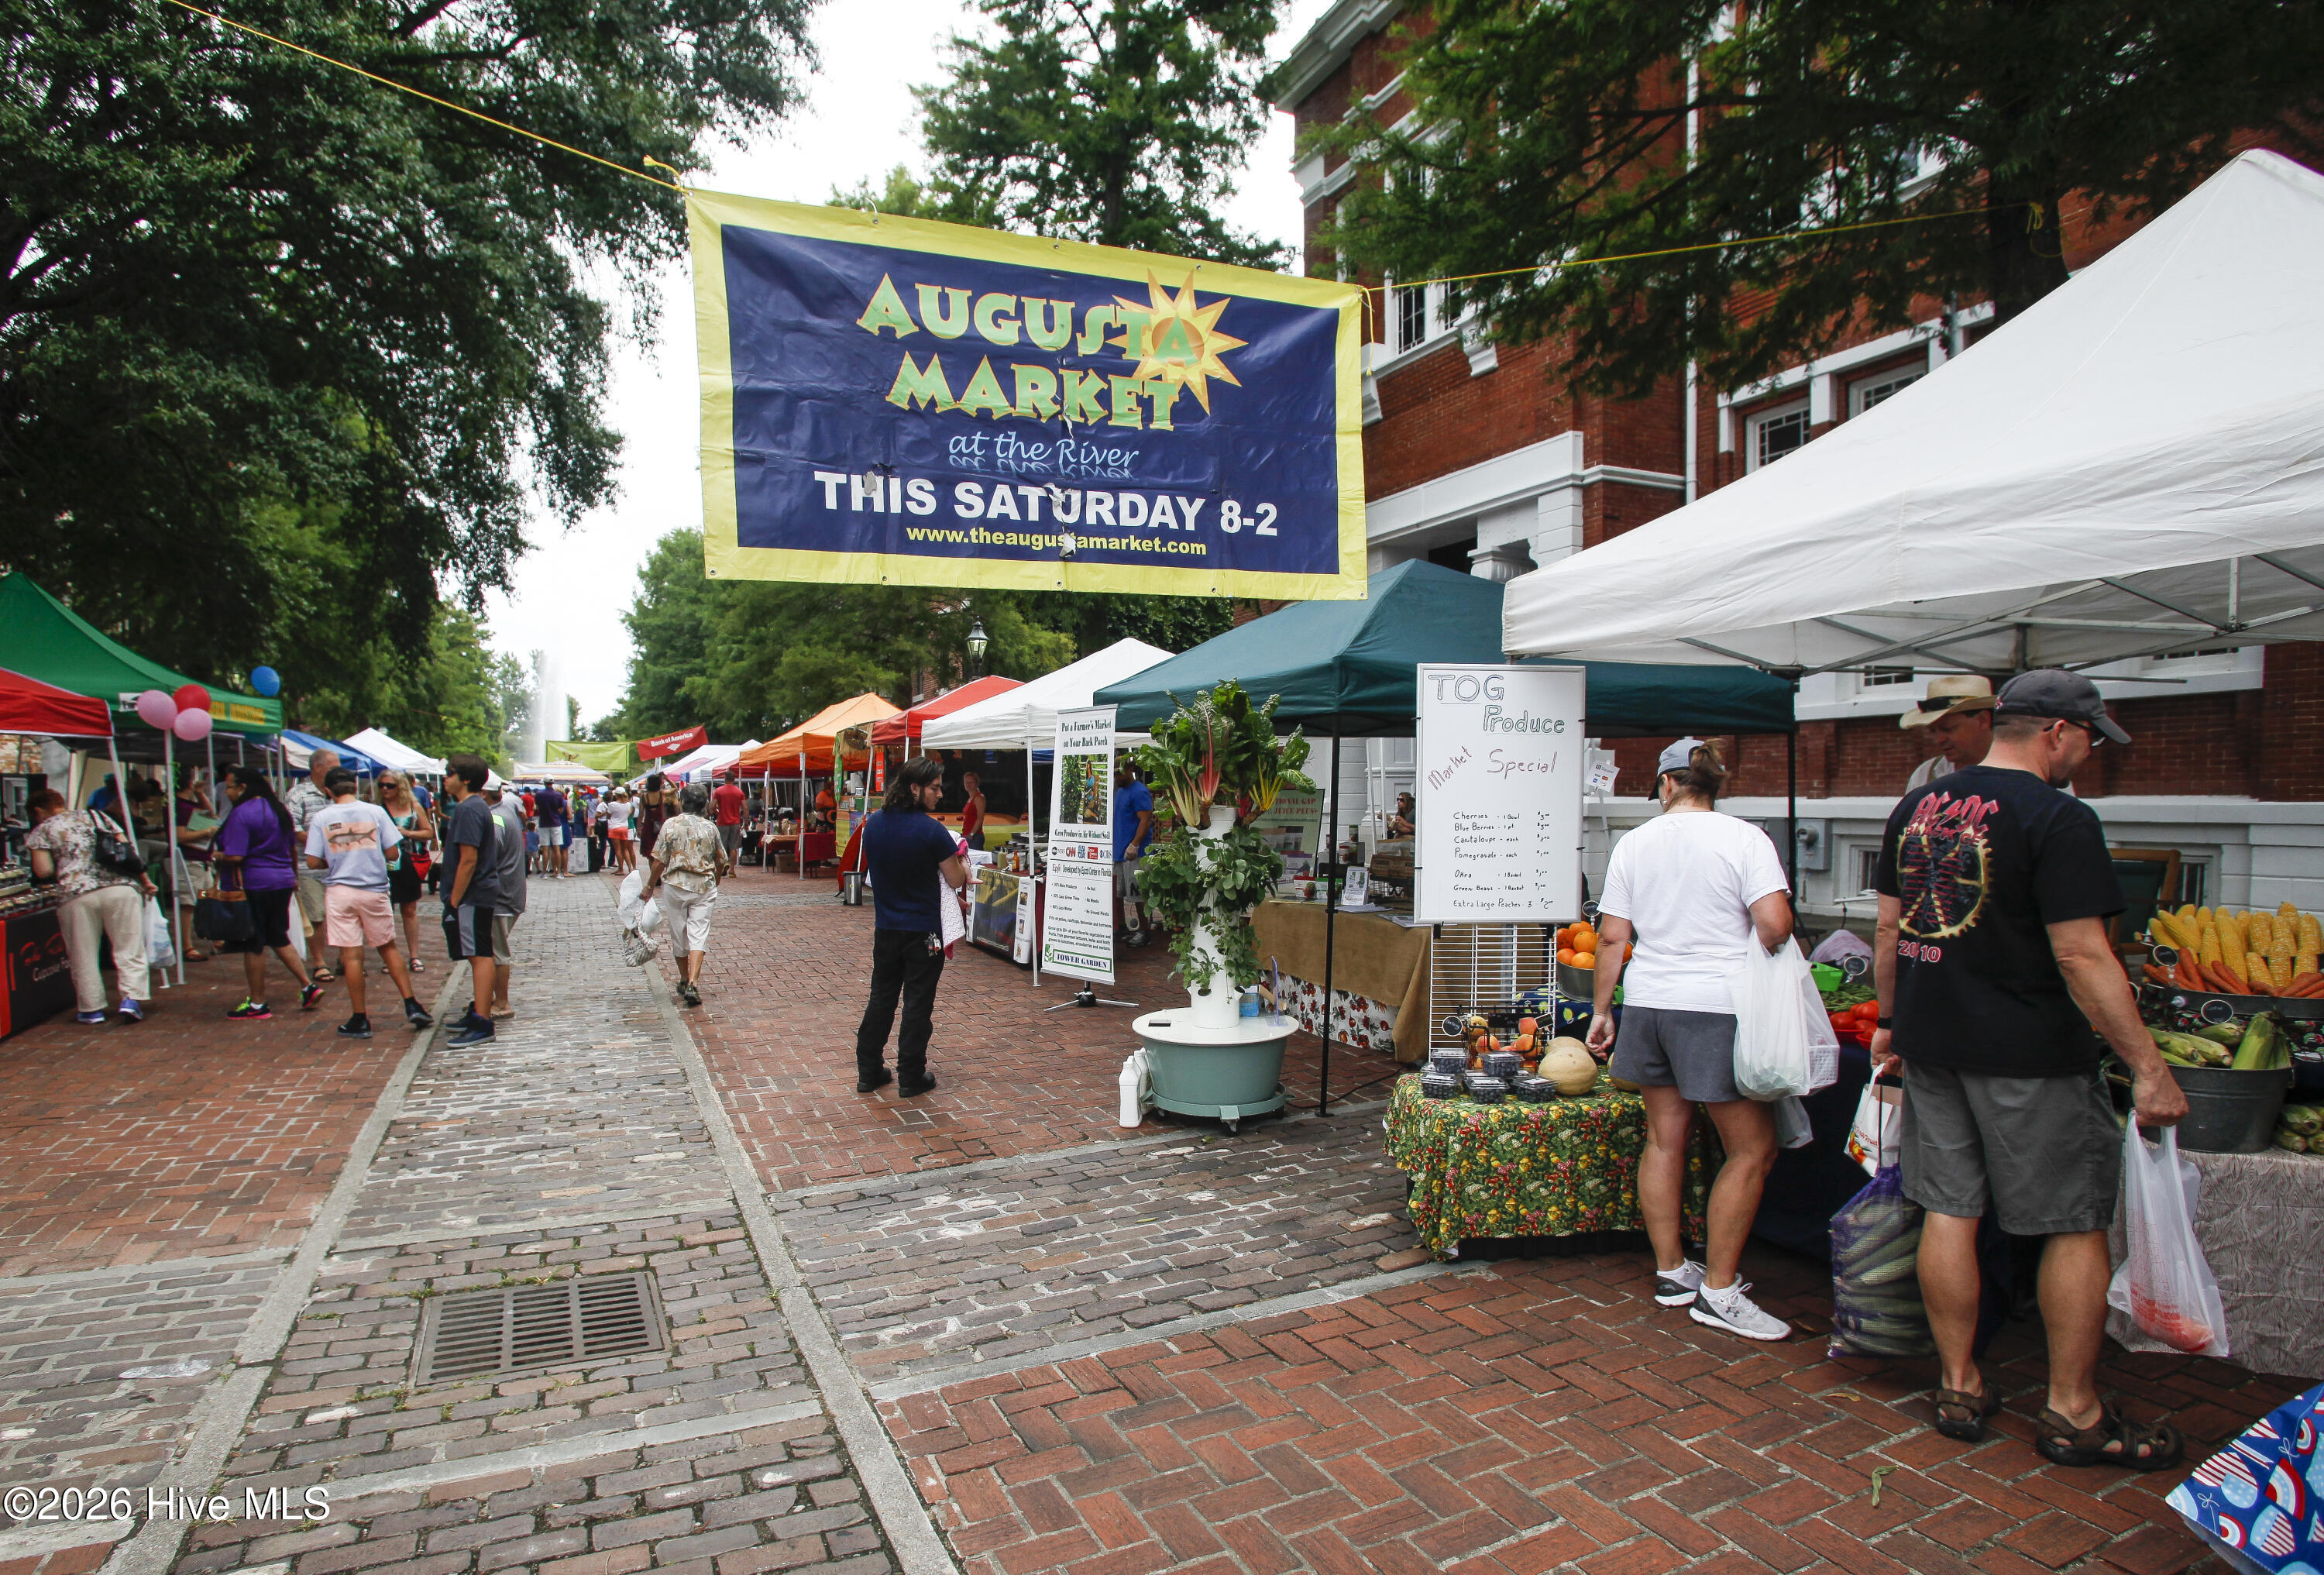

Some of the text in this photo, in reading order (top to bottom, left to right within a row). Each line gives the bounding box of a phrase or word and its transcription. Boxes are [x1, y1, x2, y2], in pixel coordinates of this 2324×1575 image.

[857, 272, 1198, 366] AUGUSTA
[885, 350, 1181, 431] MARKET
[949, 431, 1139, 467] at the River
[814, 471, 1277, 536] THIS SATURDAY 8-2
[1428, 674, 1504, 701] TOG
[1074, 720, 1093, 731] Farmer's
[1095, 719, 1111, 729] Market
[1483, 704, 1565, 733] Produce
[650, 739, 665, 748] Bank
[671, 732, 693, 743] America
[1070, 738, 1081, 748] Your
[1082, 737, 1093, 746] Back
[1095, 735, 1108, 746] Porch
[1427, 745, 1473, 791] Market
[1487, 748, 1558, 779] Special
[1452, 811, 1488, 820] Cherries
[1454, 823, 1470, 831] Blue
[1472, 822, 1494, 830] Berries
[1455, 847, 1497, 860] Pomegranate
[1063, 865, 1077, 875] Developed
[1477, 900, 1495, 910] Large
[1498, 898, 1521, 907] Peaches
[1057, 953, 1107, 968] TOWER GARDEN
[1898, 940, 1943, 963] 2010
